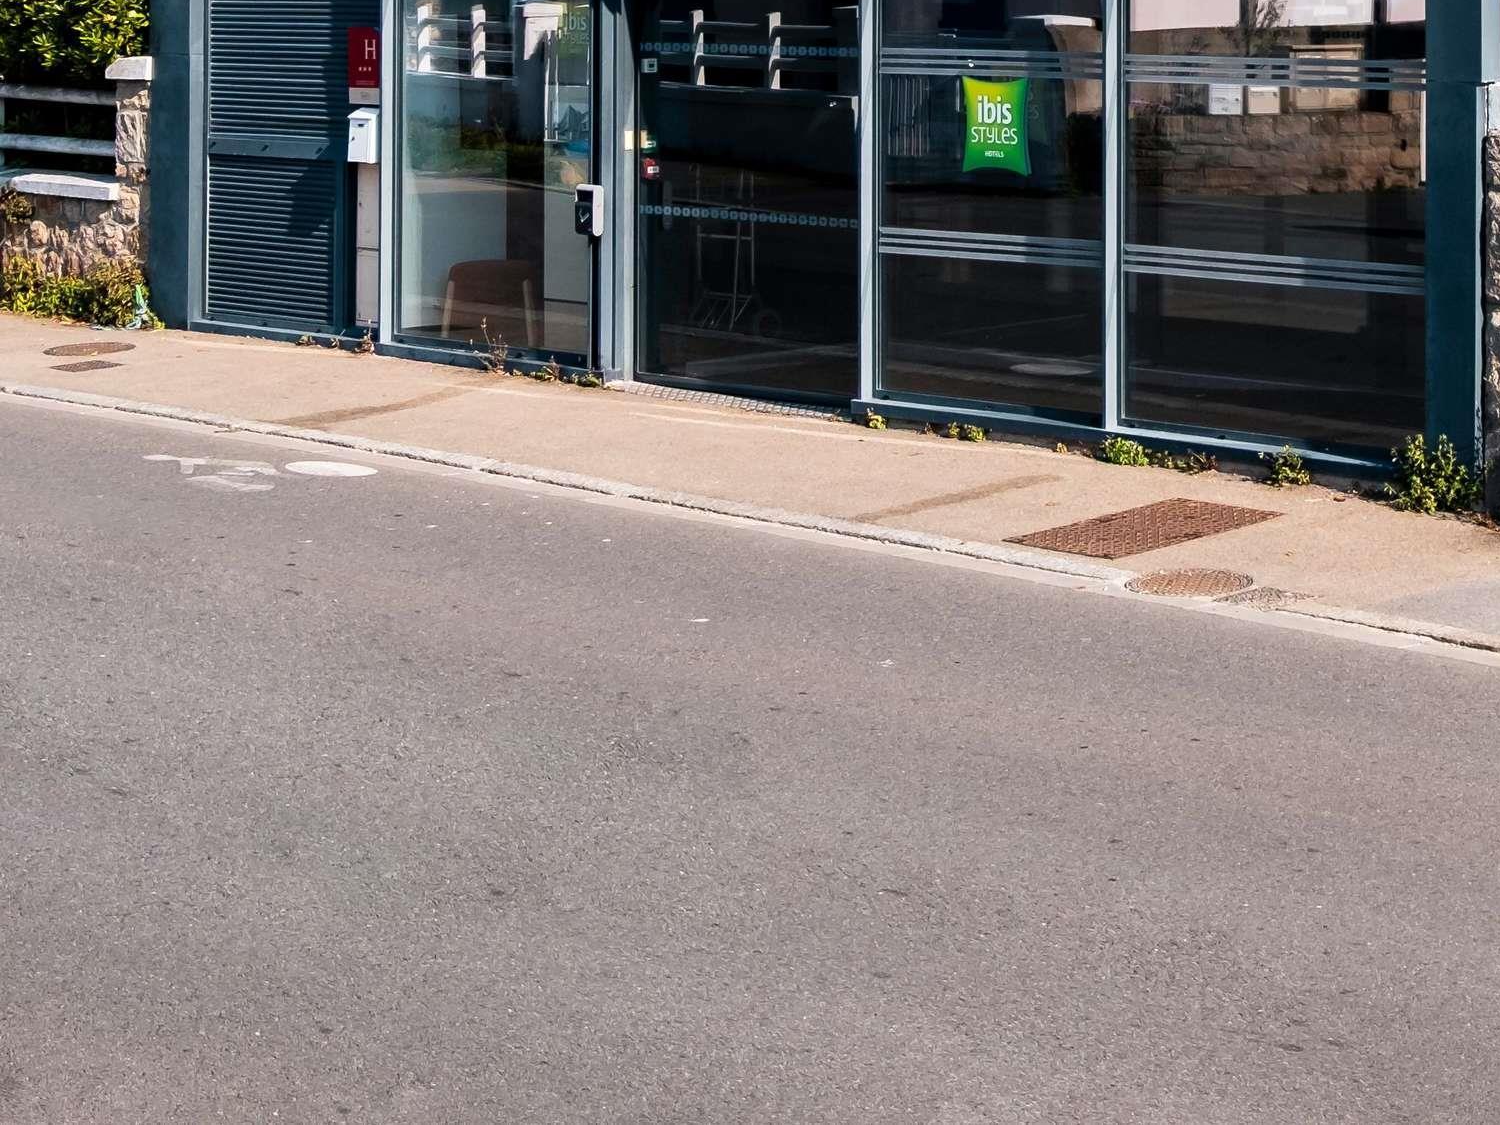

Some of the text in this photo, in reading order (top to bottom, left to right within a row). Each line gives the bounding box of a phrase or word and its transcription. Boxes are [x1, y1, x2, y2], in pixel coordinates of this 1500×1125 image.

[364, 39, 376, 60] H
[977, 95, 1012, 124] ibis
[971, 126, 1018, 144] STYLES
